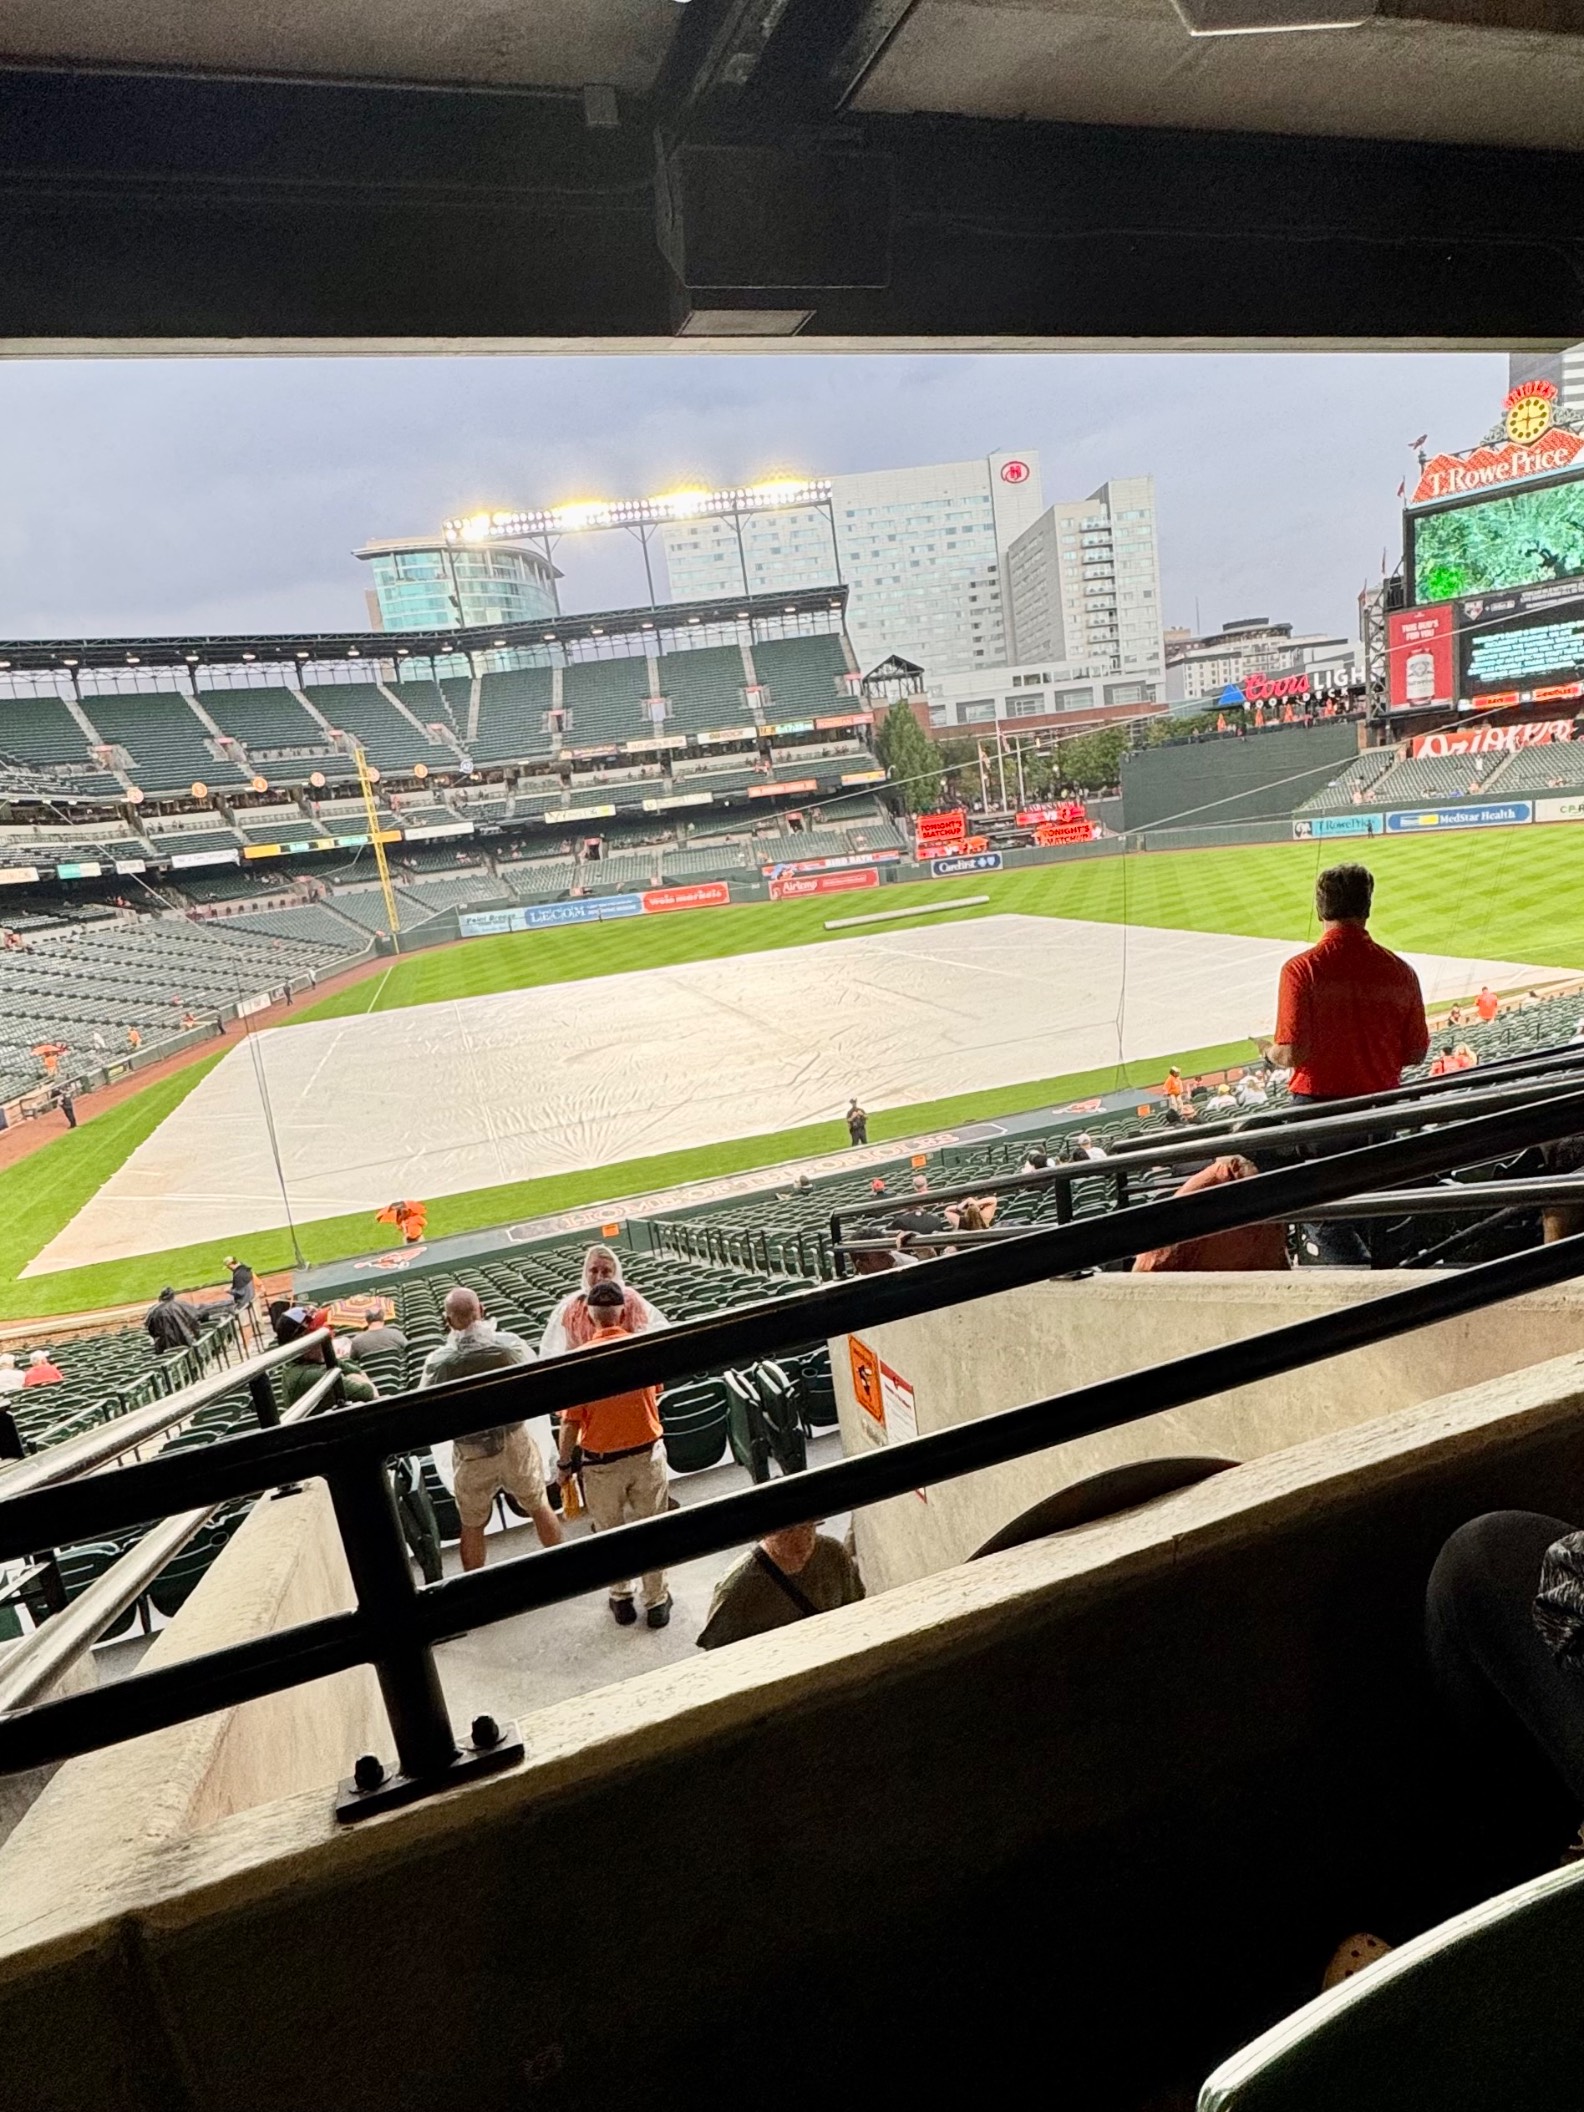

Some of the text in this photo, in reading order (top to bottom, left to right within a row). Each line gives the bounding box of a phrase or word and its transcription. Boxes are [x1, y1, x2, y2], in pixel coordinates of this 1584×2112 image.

[1449, 467, 1509, 493] Rowe
[1511, 447, 1569, 477] Price
[1244, 665, 1367, 702] Coors LIGH
[1440, 807, 1516, 824] MedStar Health
[921, 820, 962, 832] TONIGHT'S
[922, 828, 962, 839] MATCHUP
[782, 879, 818, 893] Airtemp
[530, 906, 586, 923] LECOM
